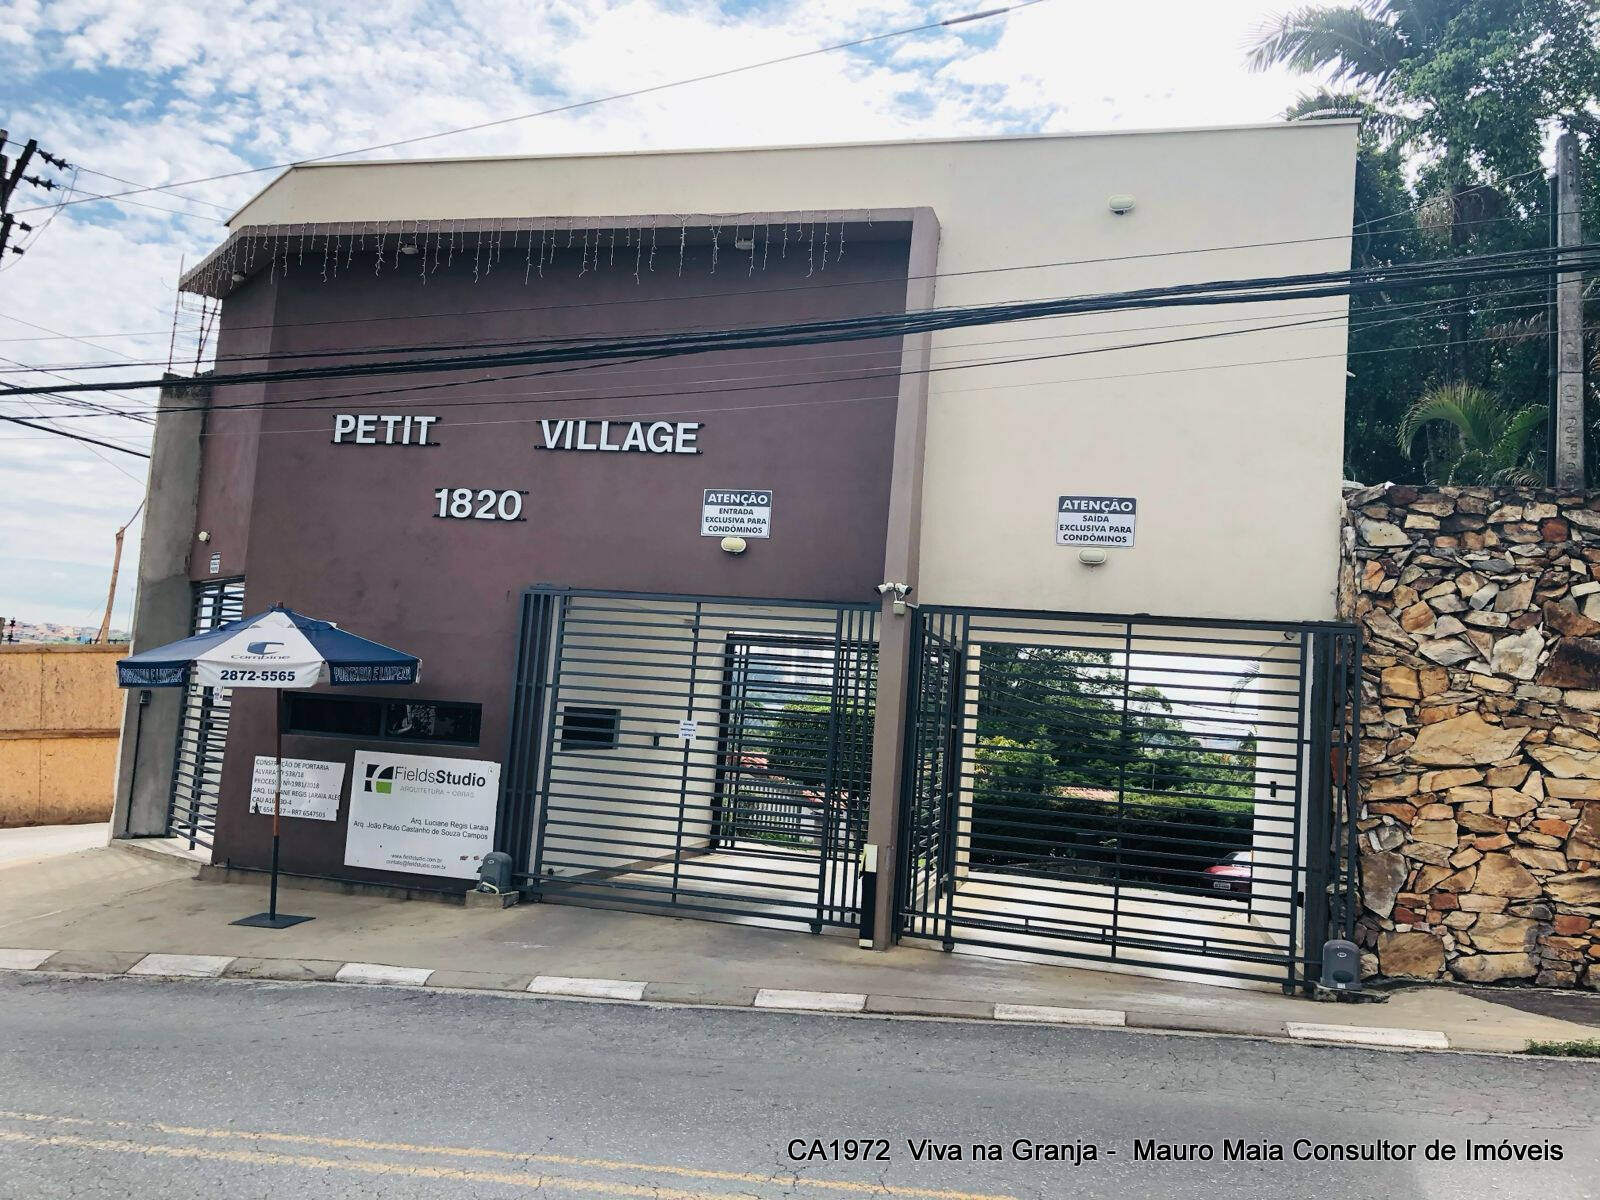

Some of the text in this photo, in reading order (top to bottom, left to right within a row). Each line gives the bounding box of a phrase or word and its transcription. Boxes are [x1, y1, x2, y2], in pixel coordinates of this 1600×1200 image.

[333, 414, 699, 453] PETIT VILLAGE
[434, 488, 523, 521] 1820
[708, 492, 768, 506] ATENÇÃO
[1062, 498, 1133, 513] ATENÇÃO
[719, 507, 754, 515] ENTRADA
[705, 516, 767, 525] EXCLUSIVA PARA
[1059, 524, 1132, 534] EXCLUSIVA PARA
[220, 669, 296, 682] 2872-5565
[394, 765, 486, 787] FieldsStudio
[424, 818, 448, 828] Luciane
[431, 828, 440, 836] de
[462, 830, 489, 841] Campos
